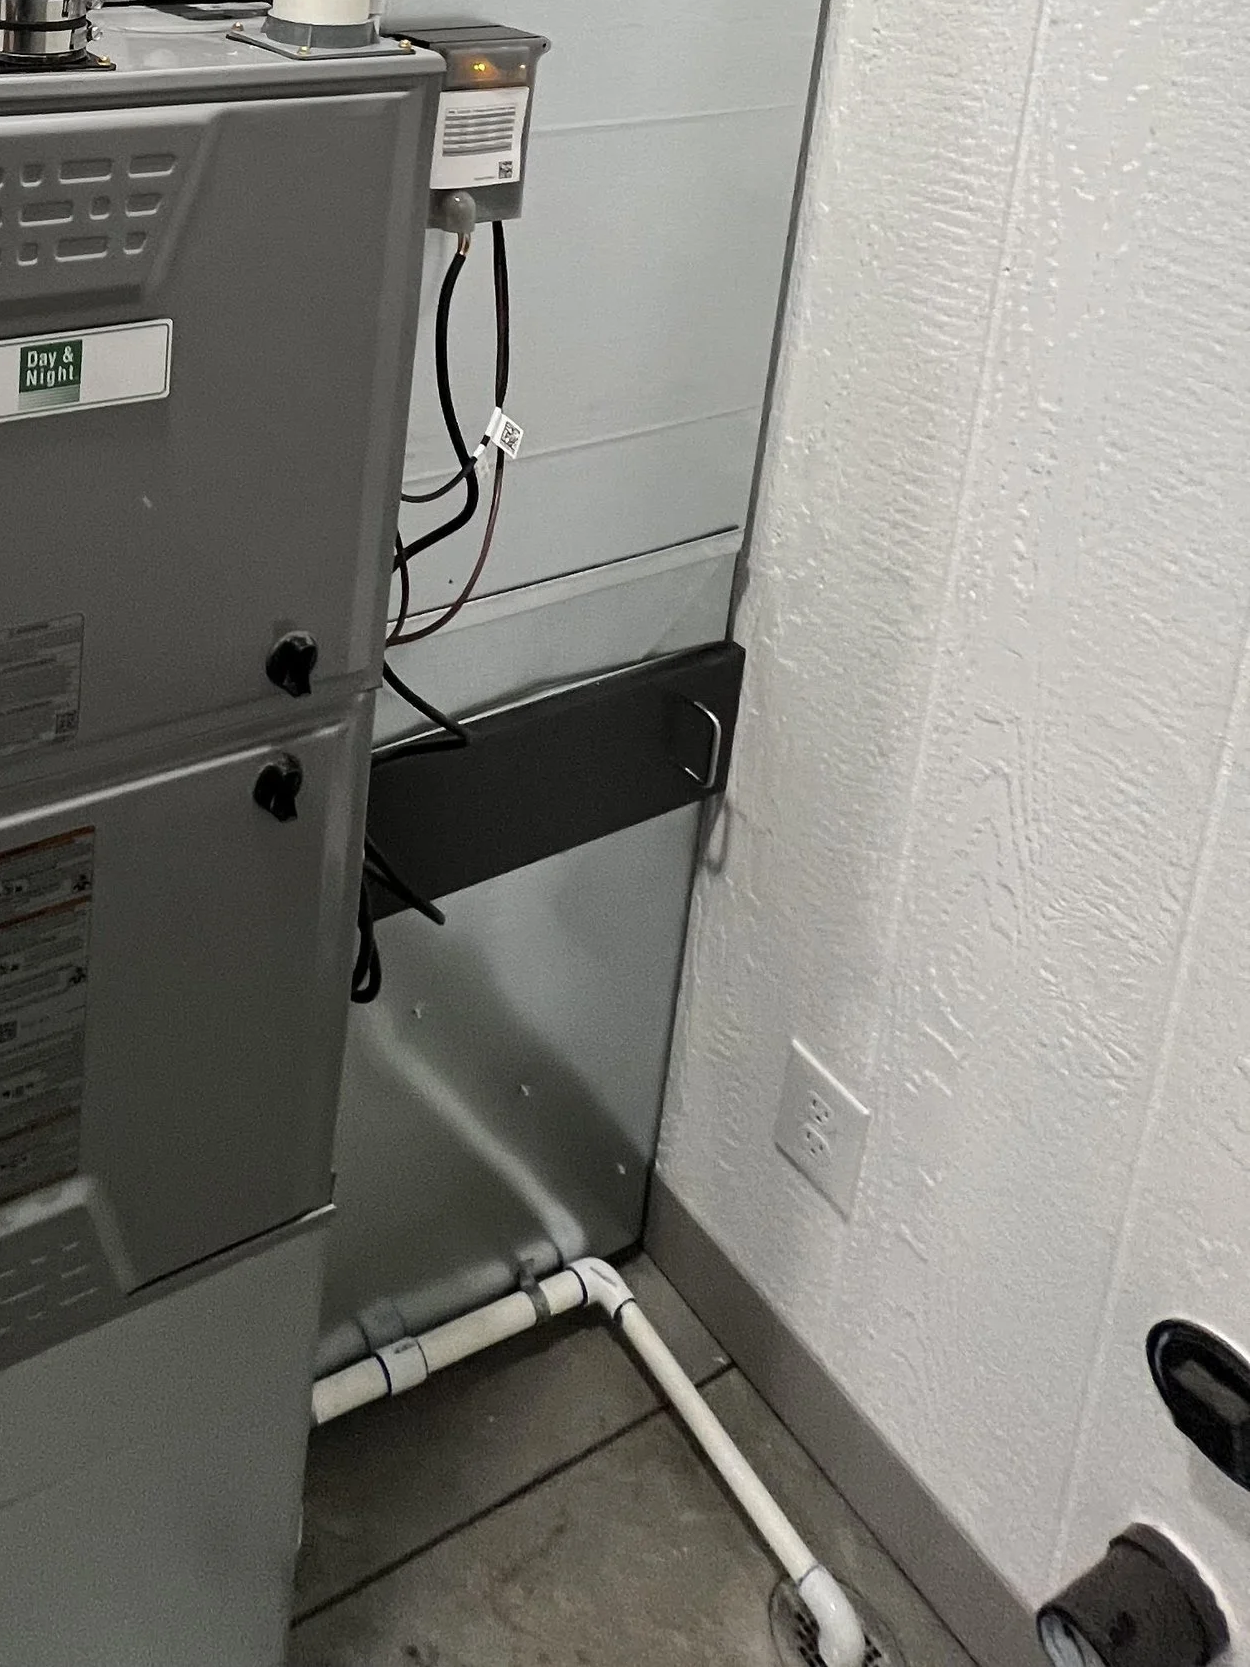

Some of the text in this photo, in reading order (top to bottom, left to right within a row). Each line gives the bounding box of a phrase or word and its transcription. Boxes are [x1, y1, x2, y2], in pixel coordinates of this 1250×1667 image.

[27, 345, 74, 369] Day &
[26, 364, 74, 387] Night
